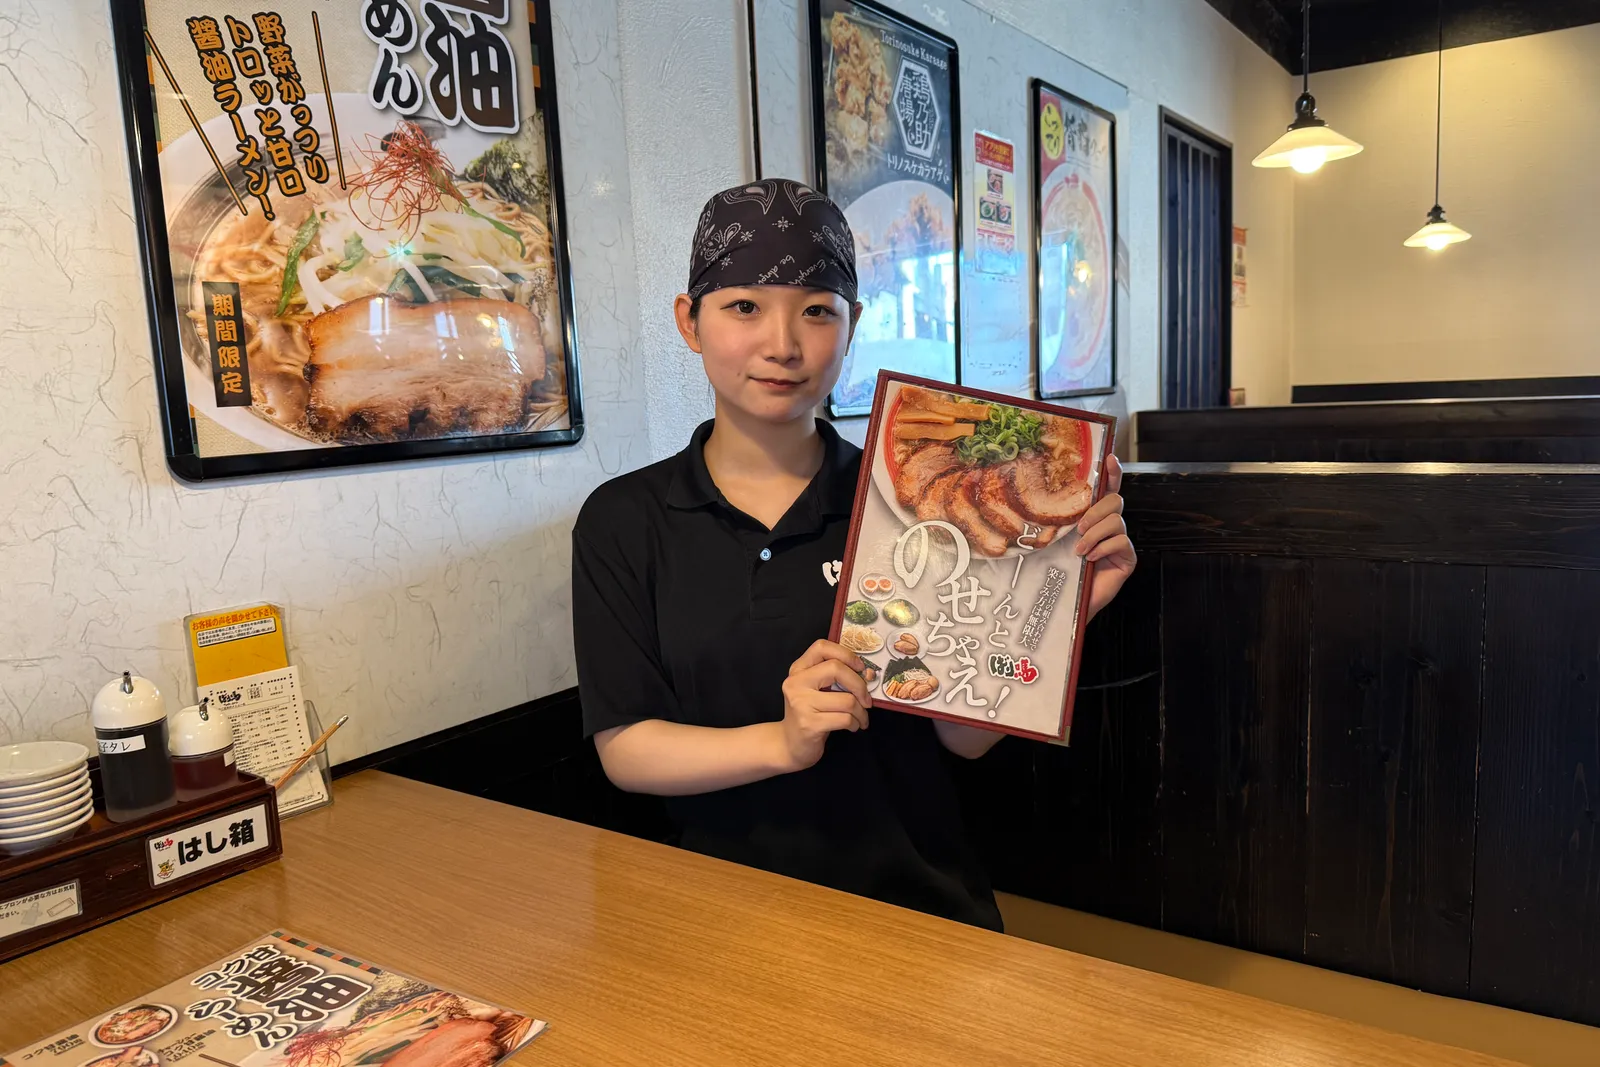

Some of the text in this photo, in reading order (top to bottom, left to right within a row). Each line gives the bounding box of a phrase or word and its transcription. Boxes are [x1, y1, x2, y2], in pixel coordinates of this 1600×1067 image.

[186, 14, 276, 221] 醤油ラーメン!
[225, 16, 307, 198] トロッと甘口
[252, 12, 329, 184] 野菜がっつり
[425, 0, 517, 128] 油
[780, 255, 795, 266] be
[211, 293, 244, 394] 期間限定
[893, 520, 1010, 718] のせちゃえ!
[988, 523, 1041, 648] どーんと
[1018, 567, 1060, 648] 楽しみ方は無限大
[178, 818, 255, 865] はし箱
[188, 999, 294, 1048] らーめん
[219, 956, 371, 1022] 醤油
